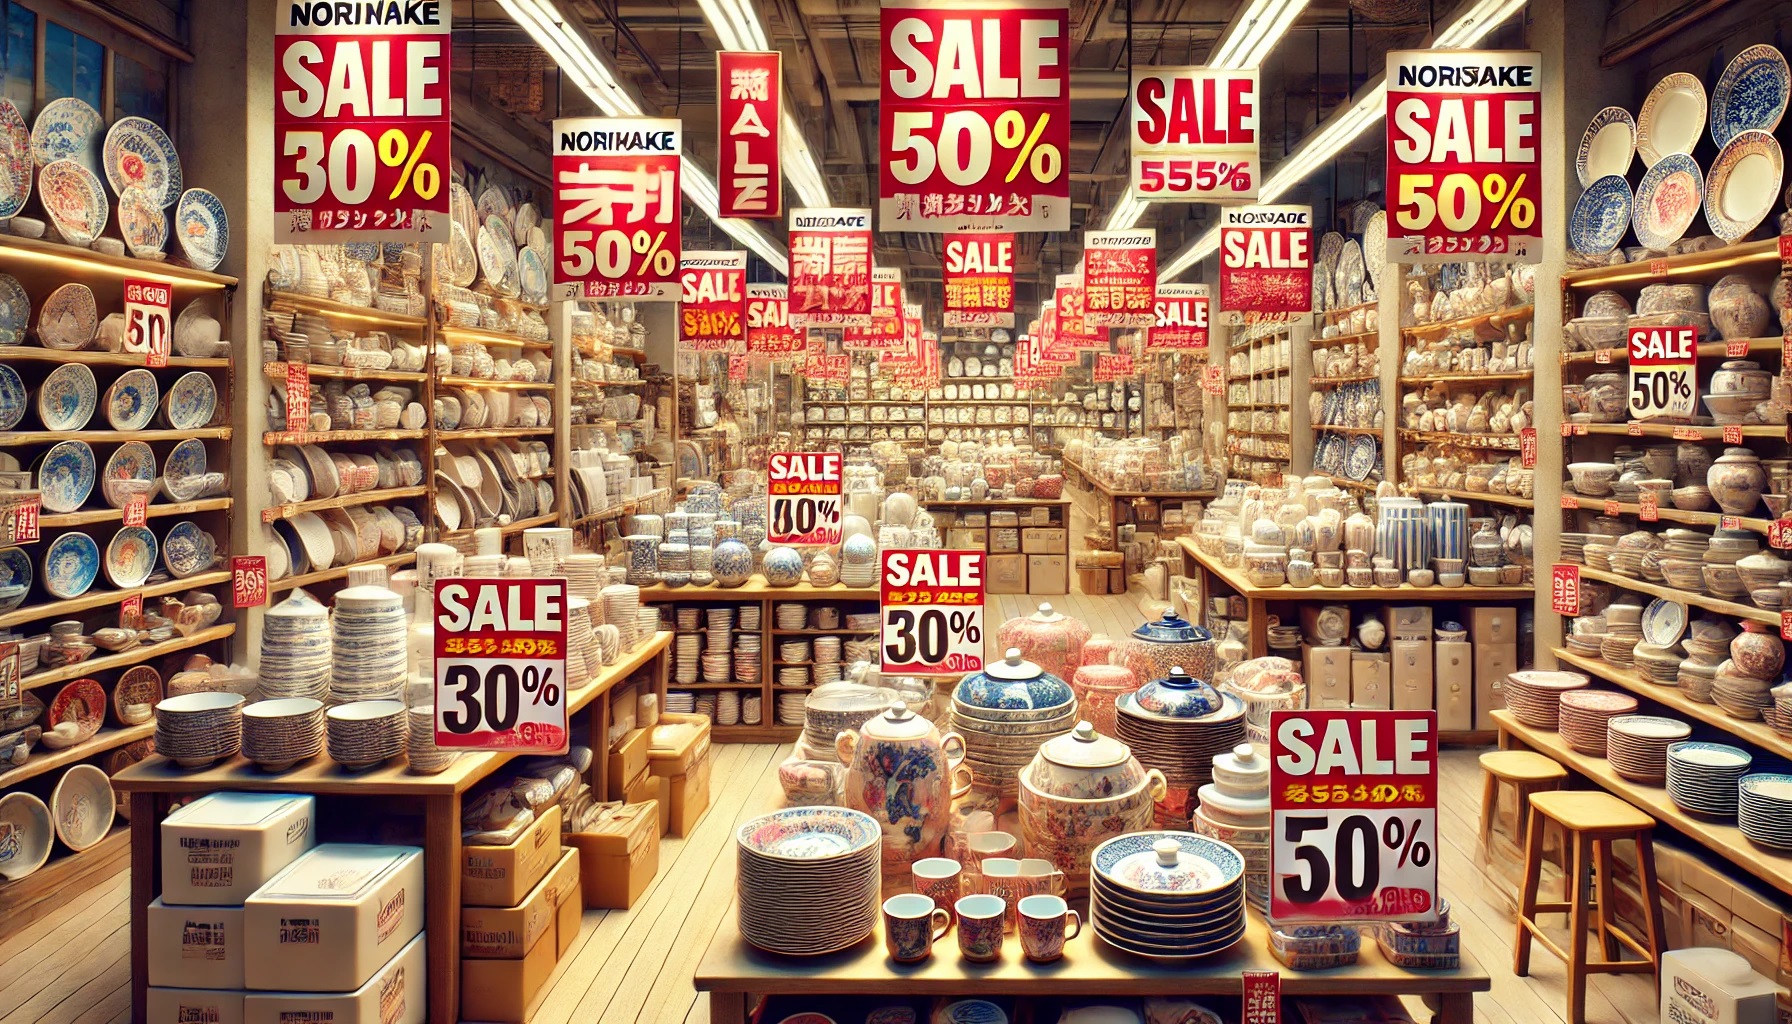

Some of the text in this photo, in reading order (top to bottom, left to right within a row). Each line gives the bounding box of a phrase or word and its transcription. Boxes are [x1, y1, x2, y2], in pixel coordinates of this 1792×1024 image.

[282, 41, 442, 117] SALE
[889, 17, 1060, 98] SALE
[1137, 77, 1254, 144] SALE
[1394, 98, 1535, 163] SALE
[282, 128, 440, 204] 30%
[889, 110, 1061, 186] 50%
[1396, 173, 1536, 232] 50%
[561, 229, 675, 278] 50%
[946, 241, 1012, 274] SALE
[1224, 231, 1309, 268] SALE
[681, 272, 741, 304] SALE
[748, 301, 788, 328] SAL
[1154, 301, 1208, 328] SALE
[1632, 330, 1692, 359] SALE
[1632, 371, 1691, 410] 50%
[770, 455, 839, 481] SALE
[886, 553, 981, 587] SALE
[438, 584, 562, 632] SALE
[885, 609, 981, 663] 30%
[443, 664, 560, 734] 30%
[1276, 717, 1430, 776] SALE
[1282, 815, 1431, 904] 50%
